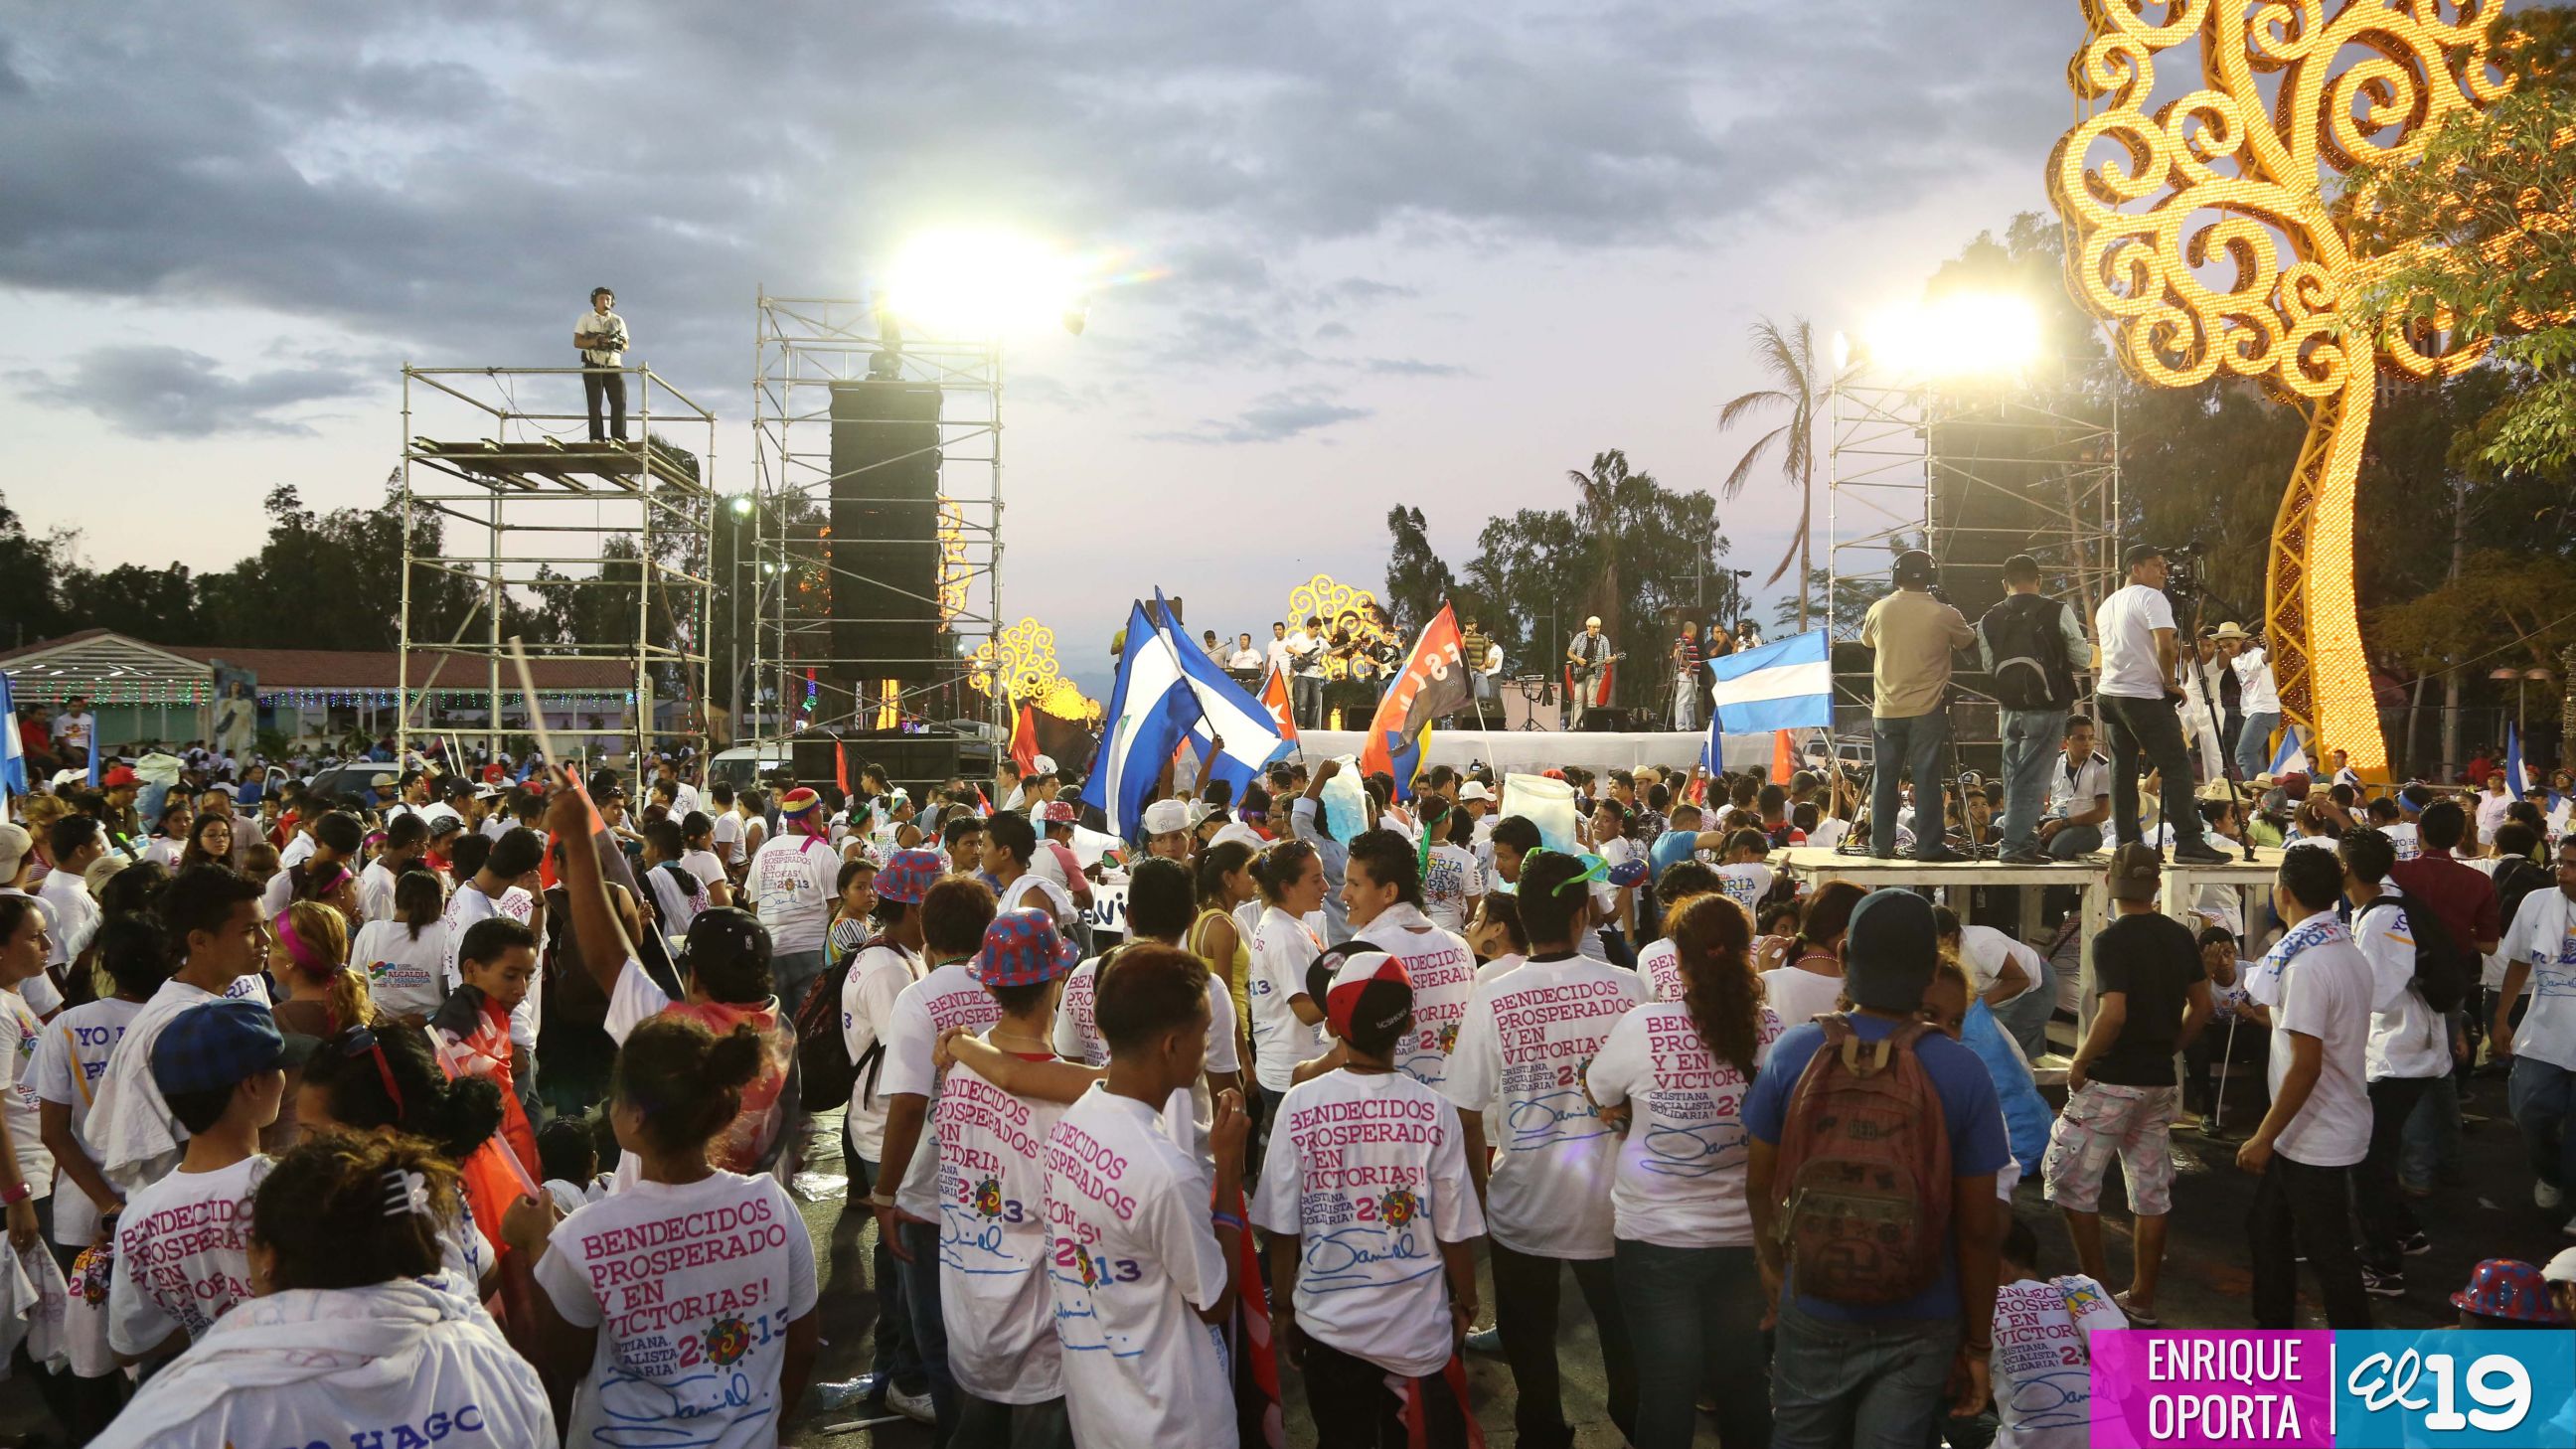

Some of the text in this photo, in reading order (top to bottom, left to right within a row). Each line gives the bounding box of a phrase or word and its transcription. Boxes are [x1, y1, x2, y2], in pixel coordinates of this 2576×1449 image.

[1491, 981, 1619, 1015] BENDECIDOS
[1497, 998, 1636, 1033] PROSPERADOS
[1502, 1027, 1546, 1048] Y EN
[1651, 1053, 1709, 1072] Y EN
[1291, 1100, 1434, 1132] BENDECIDOS
[1314, 1150, 1344, 1169] EN
[581, 1199, 771, 1260] BENDECIDOS
[588, 1224, 786, 1289] PROSPERADO
[593, 1279, 665, 1316] Y EN
[608, 1278, 768, 1339] VICTORIAS!
[1997, 1324, 2080, 1348] VICTOR
[2008, 1313, 2040, 1329] EN
